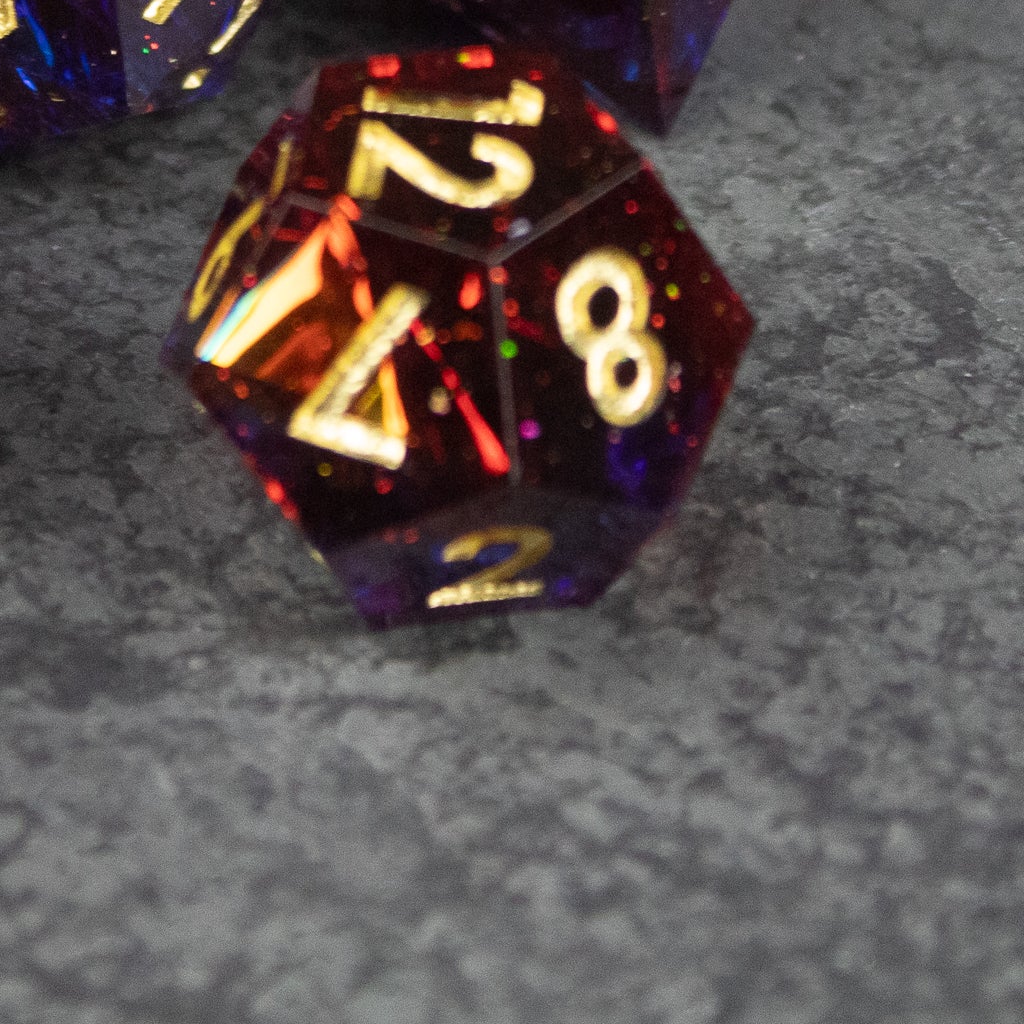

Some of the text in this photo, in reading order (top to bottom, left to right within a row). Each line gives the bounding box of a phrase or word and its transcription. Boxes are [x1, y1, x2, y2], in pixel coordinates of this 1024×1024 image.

[348, 80, 545, 209] 12
[289, 282, 426, 469] 7
[555, 246, 668, 428] 8
[427, 527, 555, 609] 2
